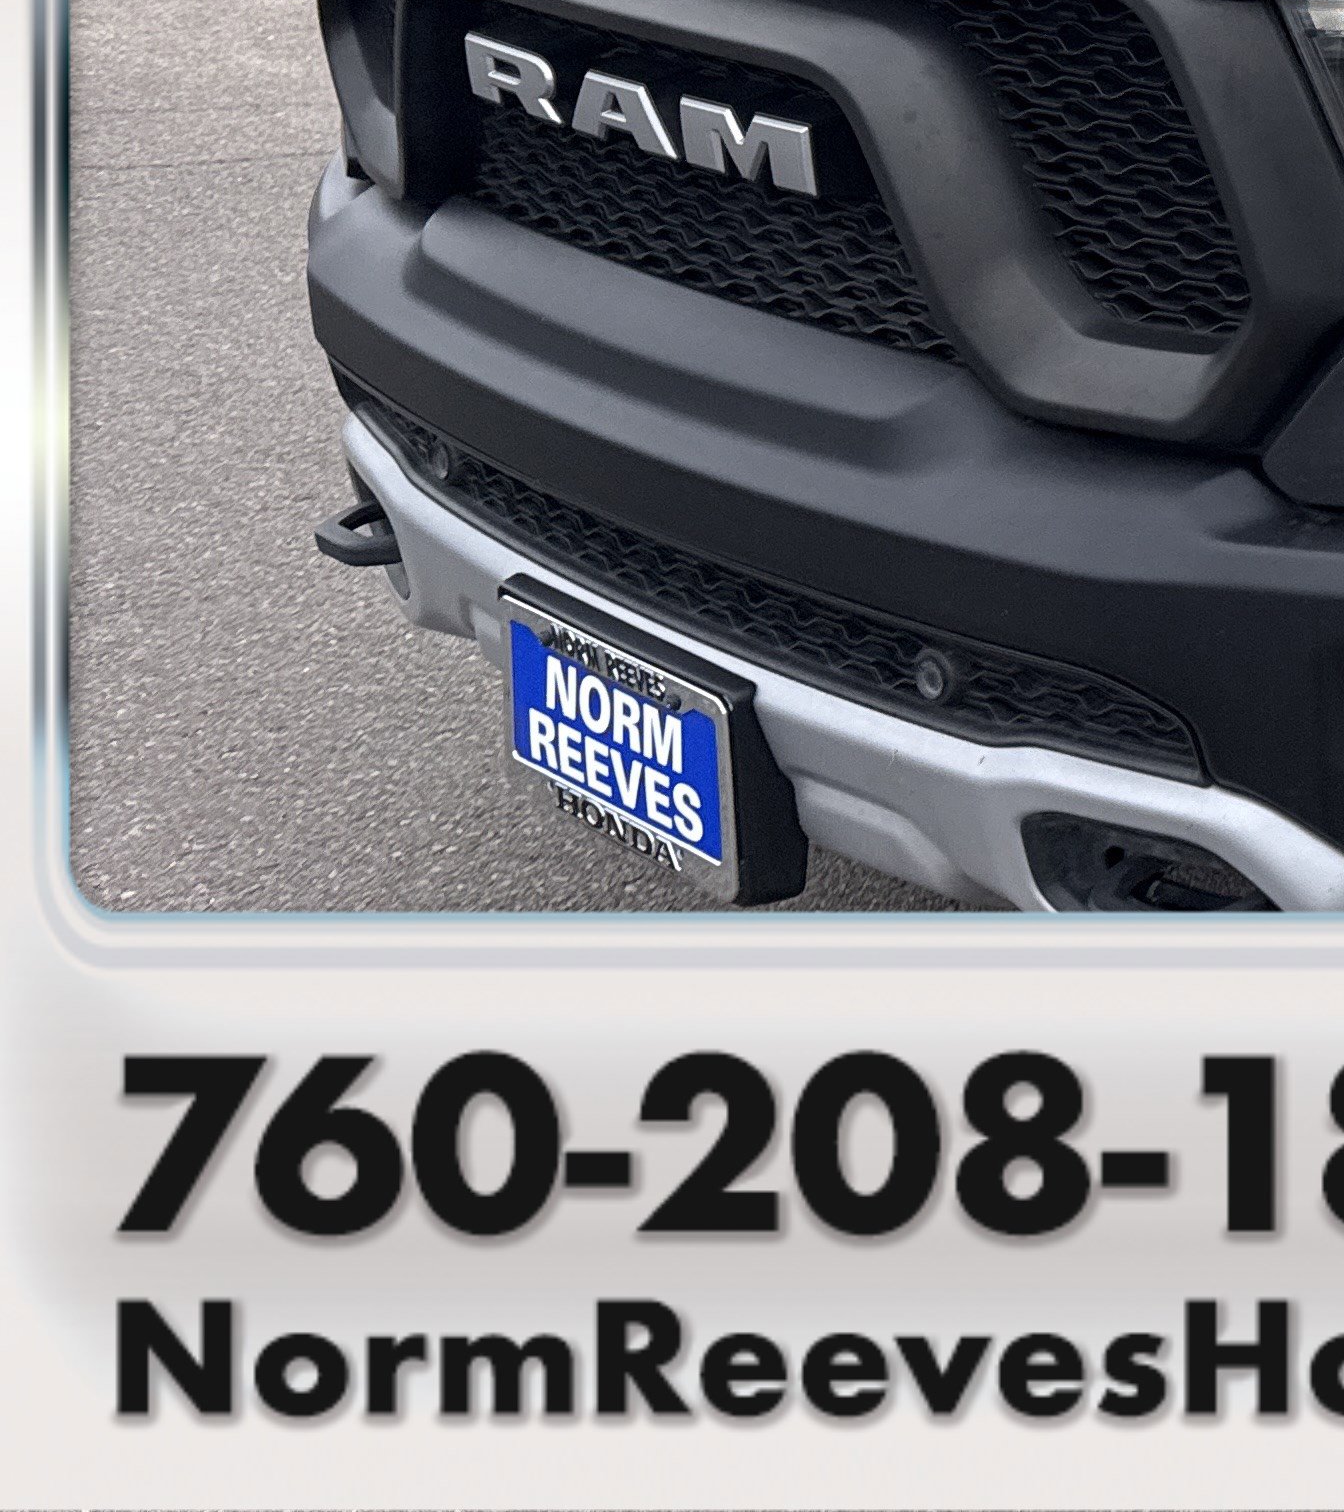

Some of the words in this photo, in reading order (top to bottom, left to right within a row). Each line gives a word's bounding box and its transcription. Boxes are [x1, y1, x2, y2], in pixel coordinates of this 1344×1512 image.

[463, 30, 819, 198] RAM
[544, 654, 684, 774] NORM
[548, 622, 602, 672] NORM
[604, 648, 667, 698] REEVES
[527, 707, 705, 844] REEVES
[554, 782, 683, 872] HONDA
